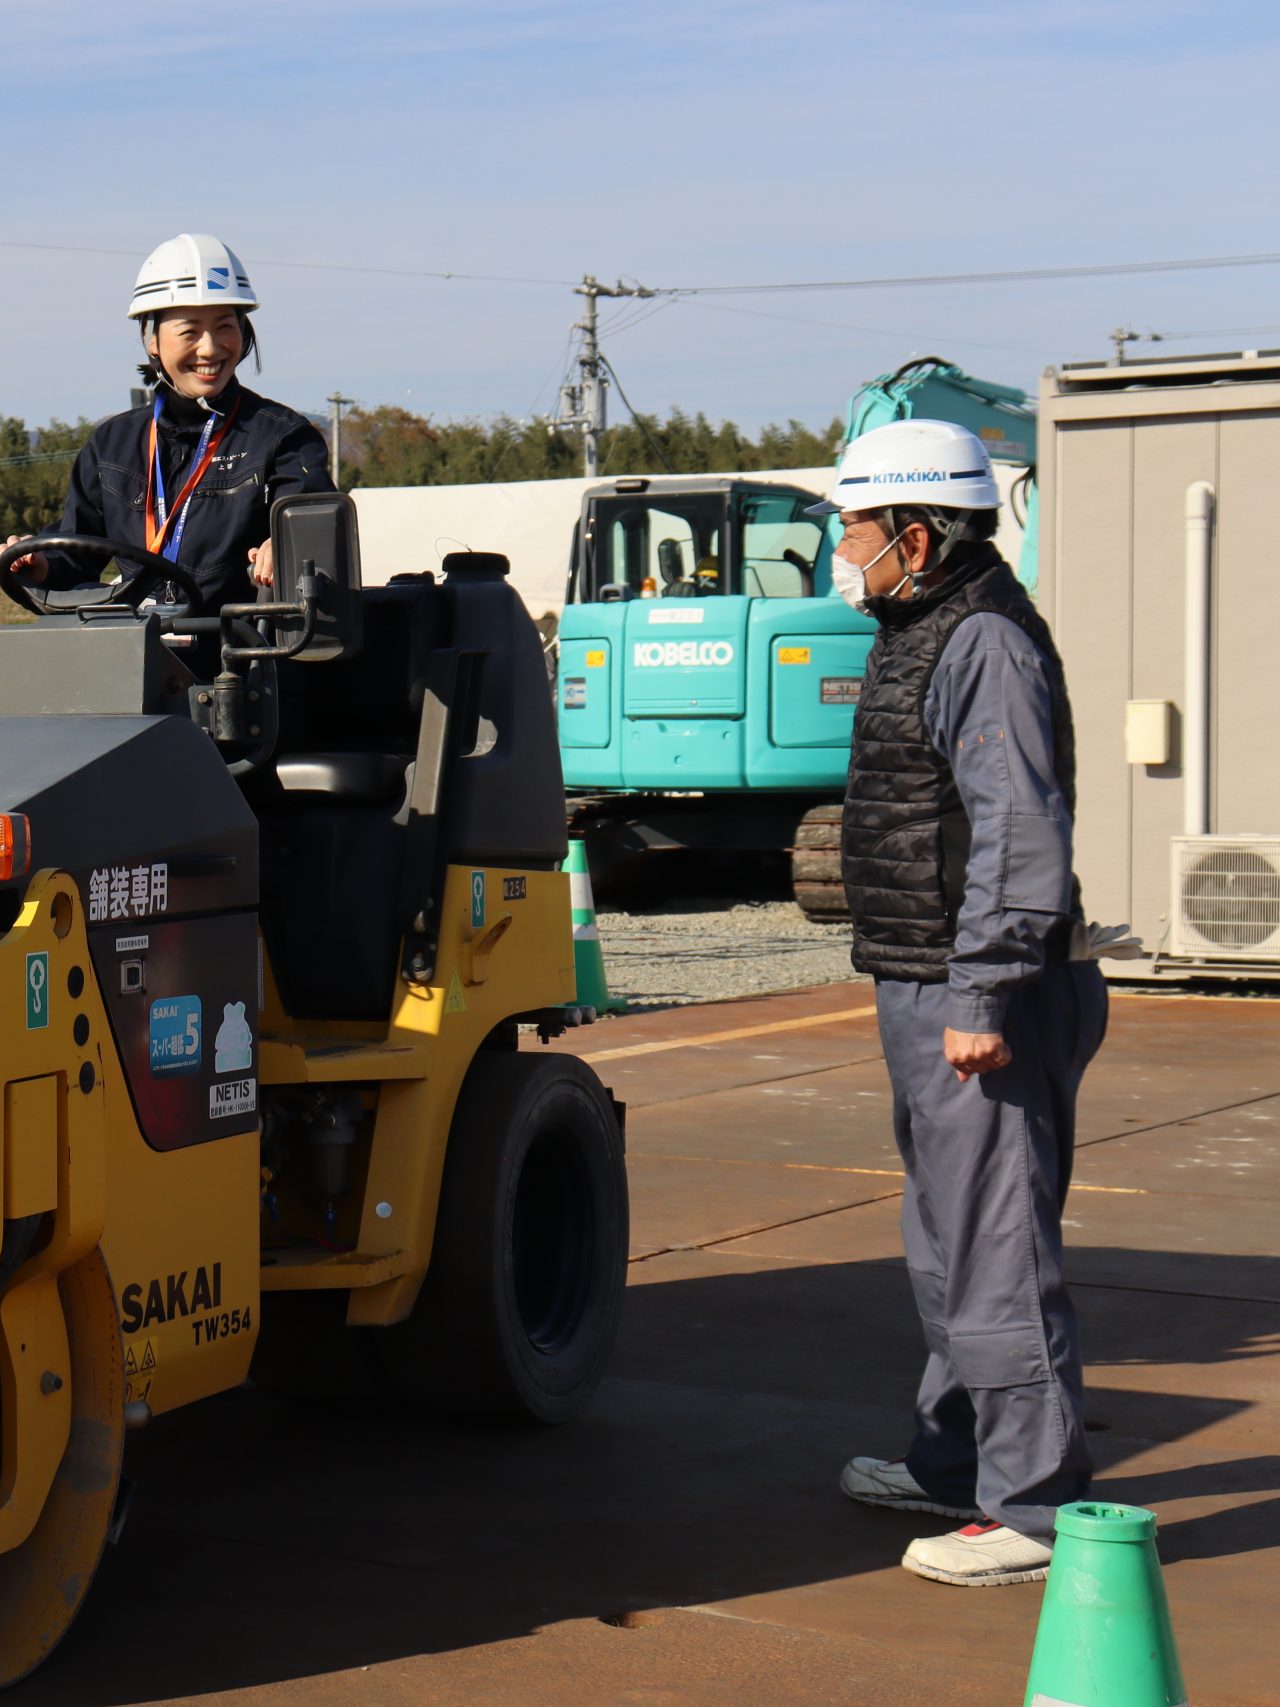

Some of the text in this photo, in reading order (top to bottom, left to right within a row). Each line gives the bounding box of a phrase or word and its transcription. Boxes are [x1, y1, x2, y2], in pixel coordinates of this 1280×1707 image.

[634, 641, 734, 667] KOBELCO
[89, 863, 168, 921] 舗装専用
[153, 1005, 178, 1020] SAKAI
[185, 1012, 199, 1056] 5
[215, 1080, 250, 1102] NETIS
[121, 1262, 222, 1334] SAKAI
[192, 1306, 251, 1346] TW354
